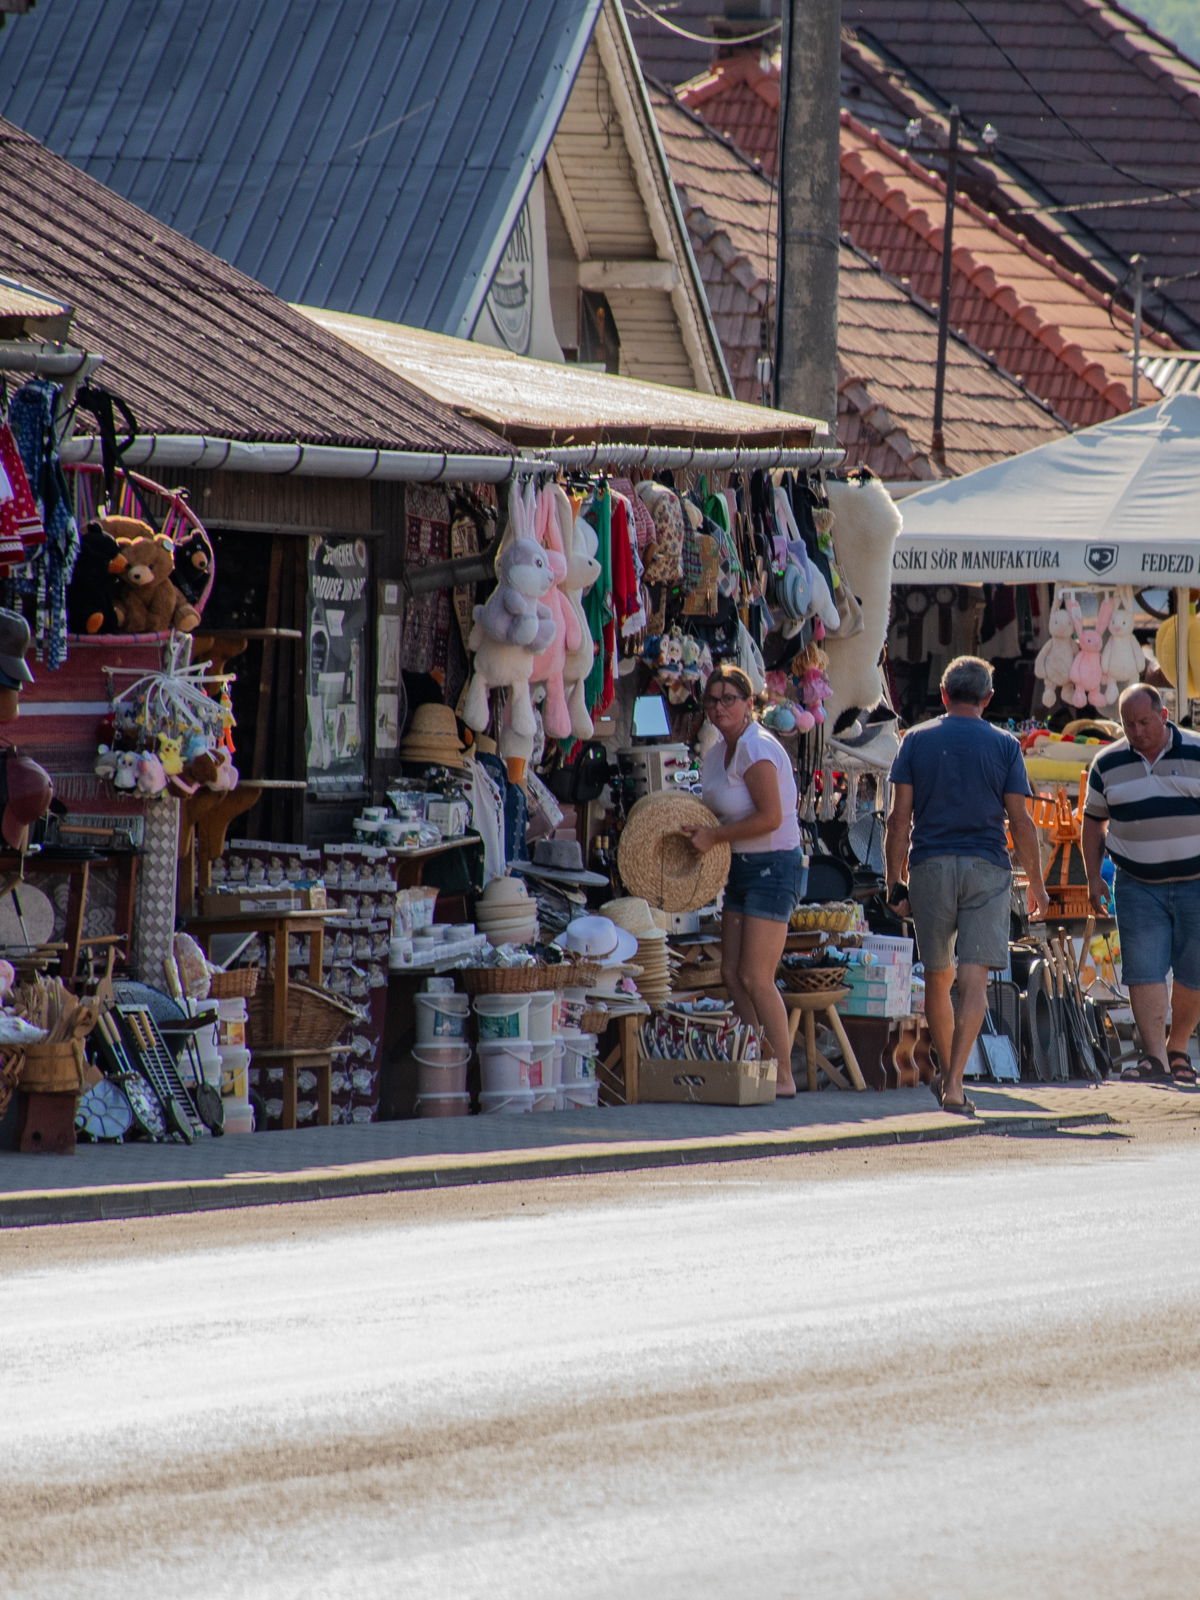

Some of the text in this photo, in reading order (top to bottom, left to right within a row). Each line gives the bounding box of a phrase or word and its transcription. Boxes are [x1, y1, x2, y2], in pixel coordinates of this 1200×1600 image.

[892, 547, 1060, 570] CSÍKI SÖR MANUFAKTÚRA
[1141, 552, 1194, 574] FEDEZD
